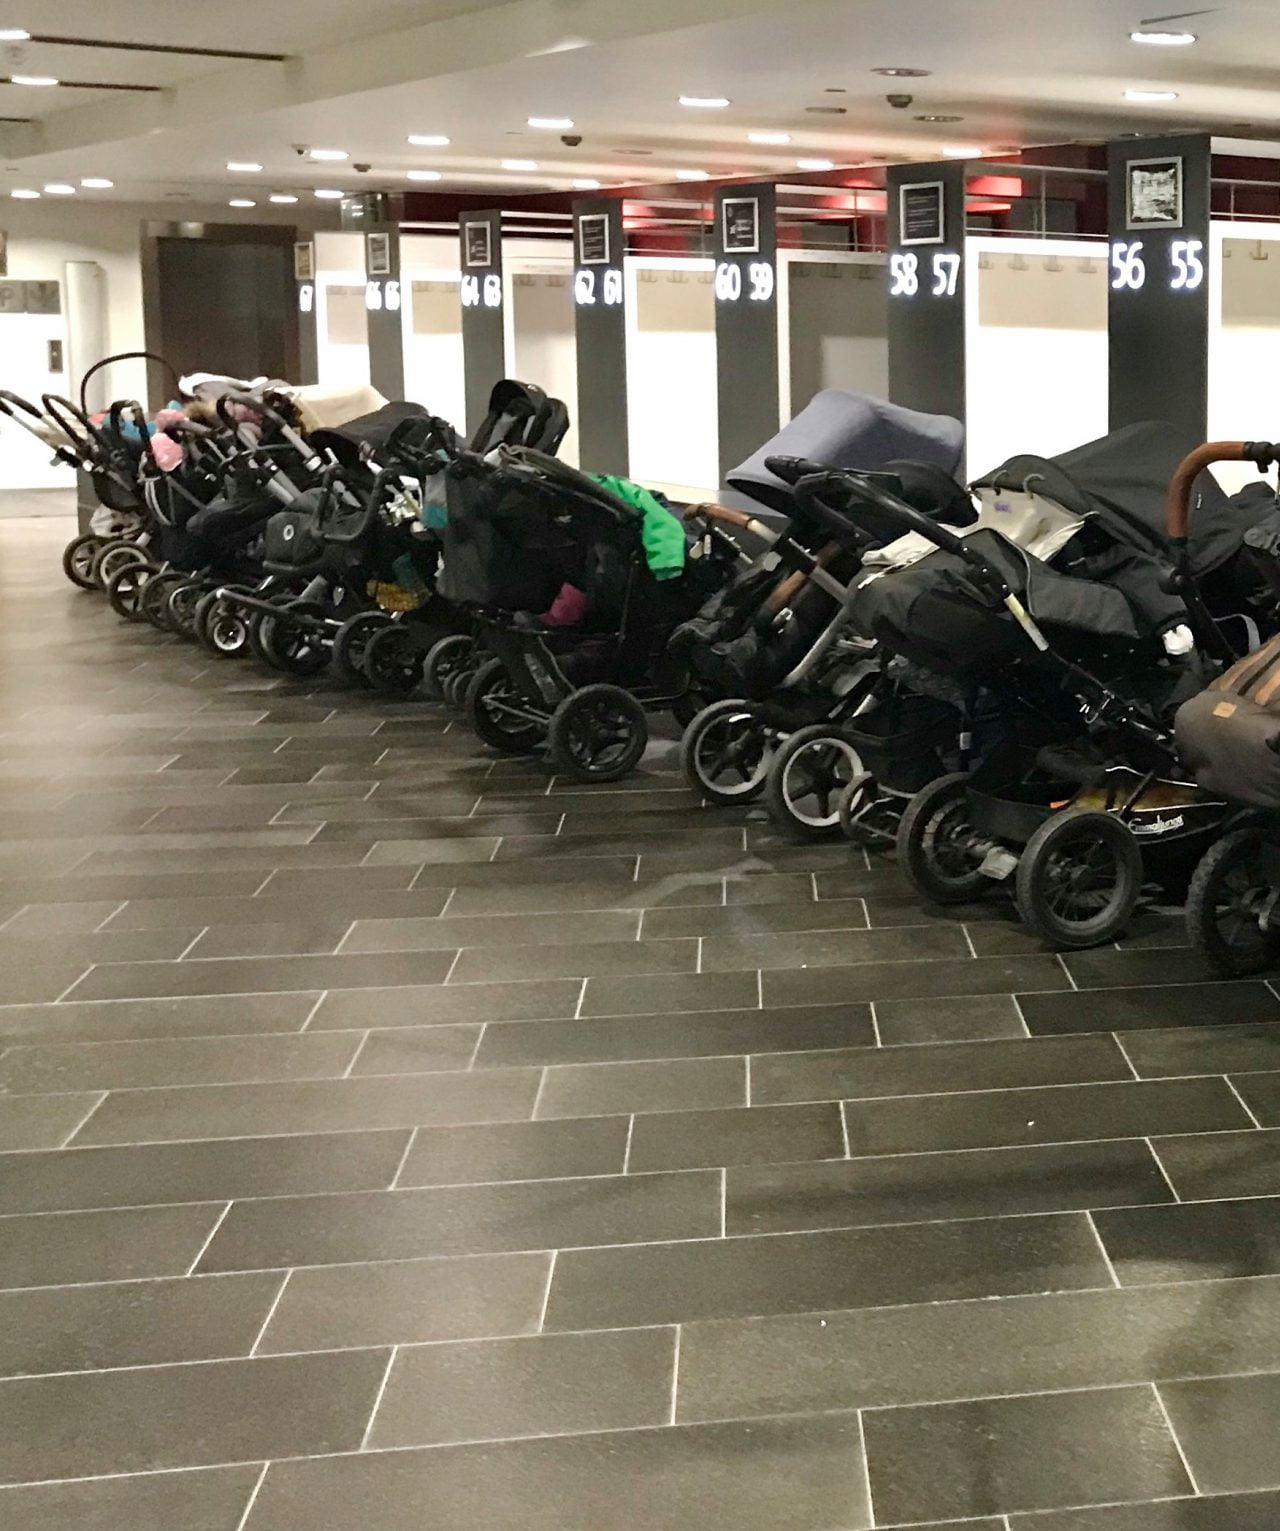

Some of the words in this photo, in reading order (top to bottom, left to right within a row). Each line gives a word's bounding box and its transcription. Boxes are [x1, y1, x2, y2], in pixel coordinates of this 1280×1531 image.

[715, 262, 742, 301] 60
[749, 262, 774, 301] 59
[890, 253, 919, 296] 58
[932, 254, 960, 296] 57
[1112, 242, 1146, 289] 56
[1170, 240, 1203, 288] 55
[575, 269, 596, 304] 62
[603, 270, 622, 305] 61
